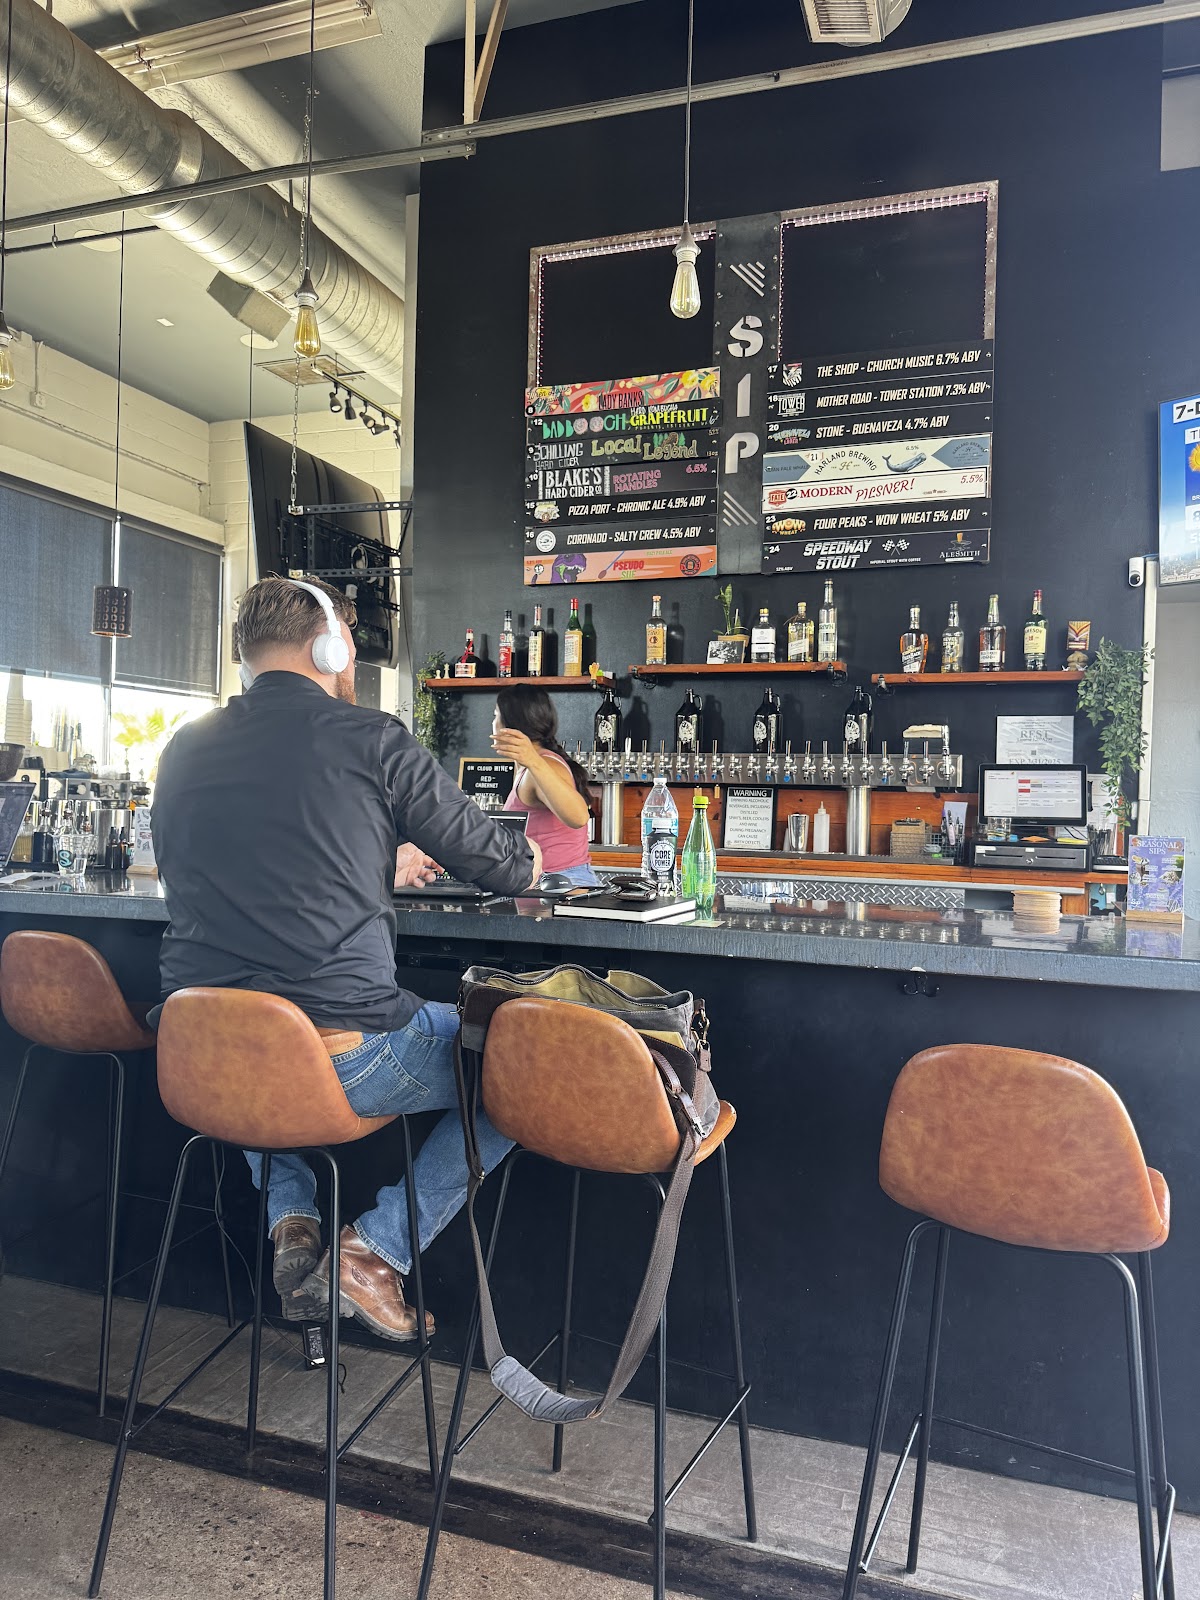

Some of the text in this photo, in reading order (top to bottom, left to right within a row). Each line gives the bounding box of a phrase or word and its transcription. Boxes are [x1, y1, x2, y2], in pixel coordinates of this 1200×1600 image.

[767, 365, 778, 373] 17
[816, 365, 835, 378] THE
[834, 363, 859, 376] SHOP
[866, 359, 903, 373] CHURCH
[905, 355, 934, 369] MUSIC
[935, 353, 960, 366] 6.7%
[961, 350, 981, 363] ABV
[618, 390, 643, 409] BANKS
[768, 395, 778, 403] 18
[816, 395, 849, 409] MOTHER
[850, 391, 872, 405] ROAD
[879, 388, 907, 402] TOWER
[907, 385, 944, 399] STATION
[945, 383, 967, 396] 7.3%
[967, 381, 987, 394] ABV
[778, 396, 805, 413] TOWER
[533, 418, 543, 426] 12
[629, 407, 708, 427] GRAPEFRUIT
[768, 424, 779, 432] 20
[816, 425, 844, 440] STONE
[852, 420, 903, 436] BUENAVEZA
[905, 417, 928, 430] 4.7%
[929, 415, 949, 429] ABV
[533, 442, 584, 461] SCHILLING
[810, 453, 818, 462] 21
[535, 459, 553, 471] HARD
[685, 463, 708, 474] 6.5%
[814, 450, 878, 475] HARLAND BREWING
[528, 473, 539, 481] 10
[545, 466, 603, 488] BLAKE'S
[613, 469, 661, 484] ROTATING
[960, 474, 984, 484] 5.5%
[614, 478, 658, 493] HANDLES
[800, 478, 916, 501] MODERN PILSNER!
[545, 487, 568, 500] HARD
[569, 485, 595, 497] CIDER
[771, 493, 784, 501] FATE
[786, 490, 798, 498] 22
[568, 504, 589, 516] PIZZA
[590, 503, 611, 515] PORT
[617, 500, 651, 513] CHRONIC
[651, 499, 667, 510] ALE
[667, 497, 688, 509] 4.9%
[689, 495, 706, 507] ABV
[765, 515, 776, 523] 23
[814, 518, 838, 531] FOUR
[838, 515, 867, 529] PEAKS
[875, 513, 899, 526] WOW
[900, 511, 932, 525] WHEAT
[933, 509, 949, 522] 5%
[949, 508, 970, 521] ABV
[566, 532, 608, 545] CORONADO
[614, 530, 639, 543] SALTY
[638, 528, 662, 541] CREW
[662, 527, 683, 539] 4.5%
[684, 526, 701, 538] ABV
[768, 544, 780, 553] 24
[803, 539, 873, 556] SPEEDWAY
[613, 560, 645, 570] PSEUDO
[815, 554, 860, 570] STOUT
[733, 789, 767, 798] WARNING
[1136, 840, 1180, 849] SEASONAL
[654, 850, 671, 860] CORE
[1148, 847, 1166, 855] SIPS
[654, 859, 671, 867] POWER
